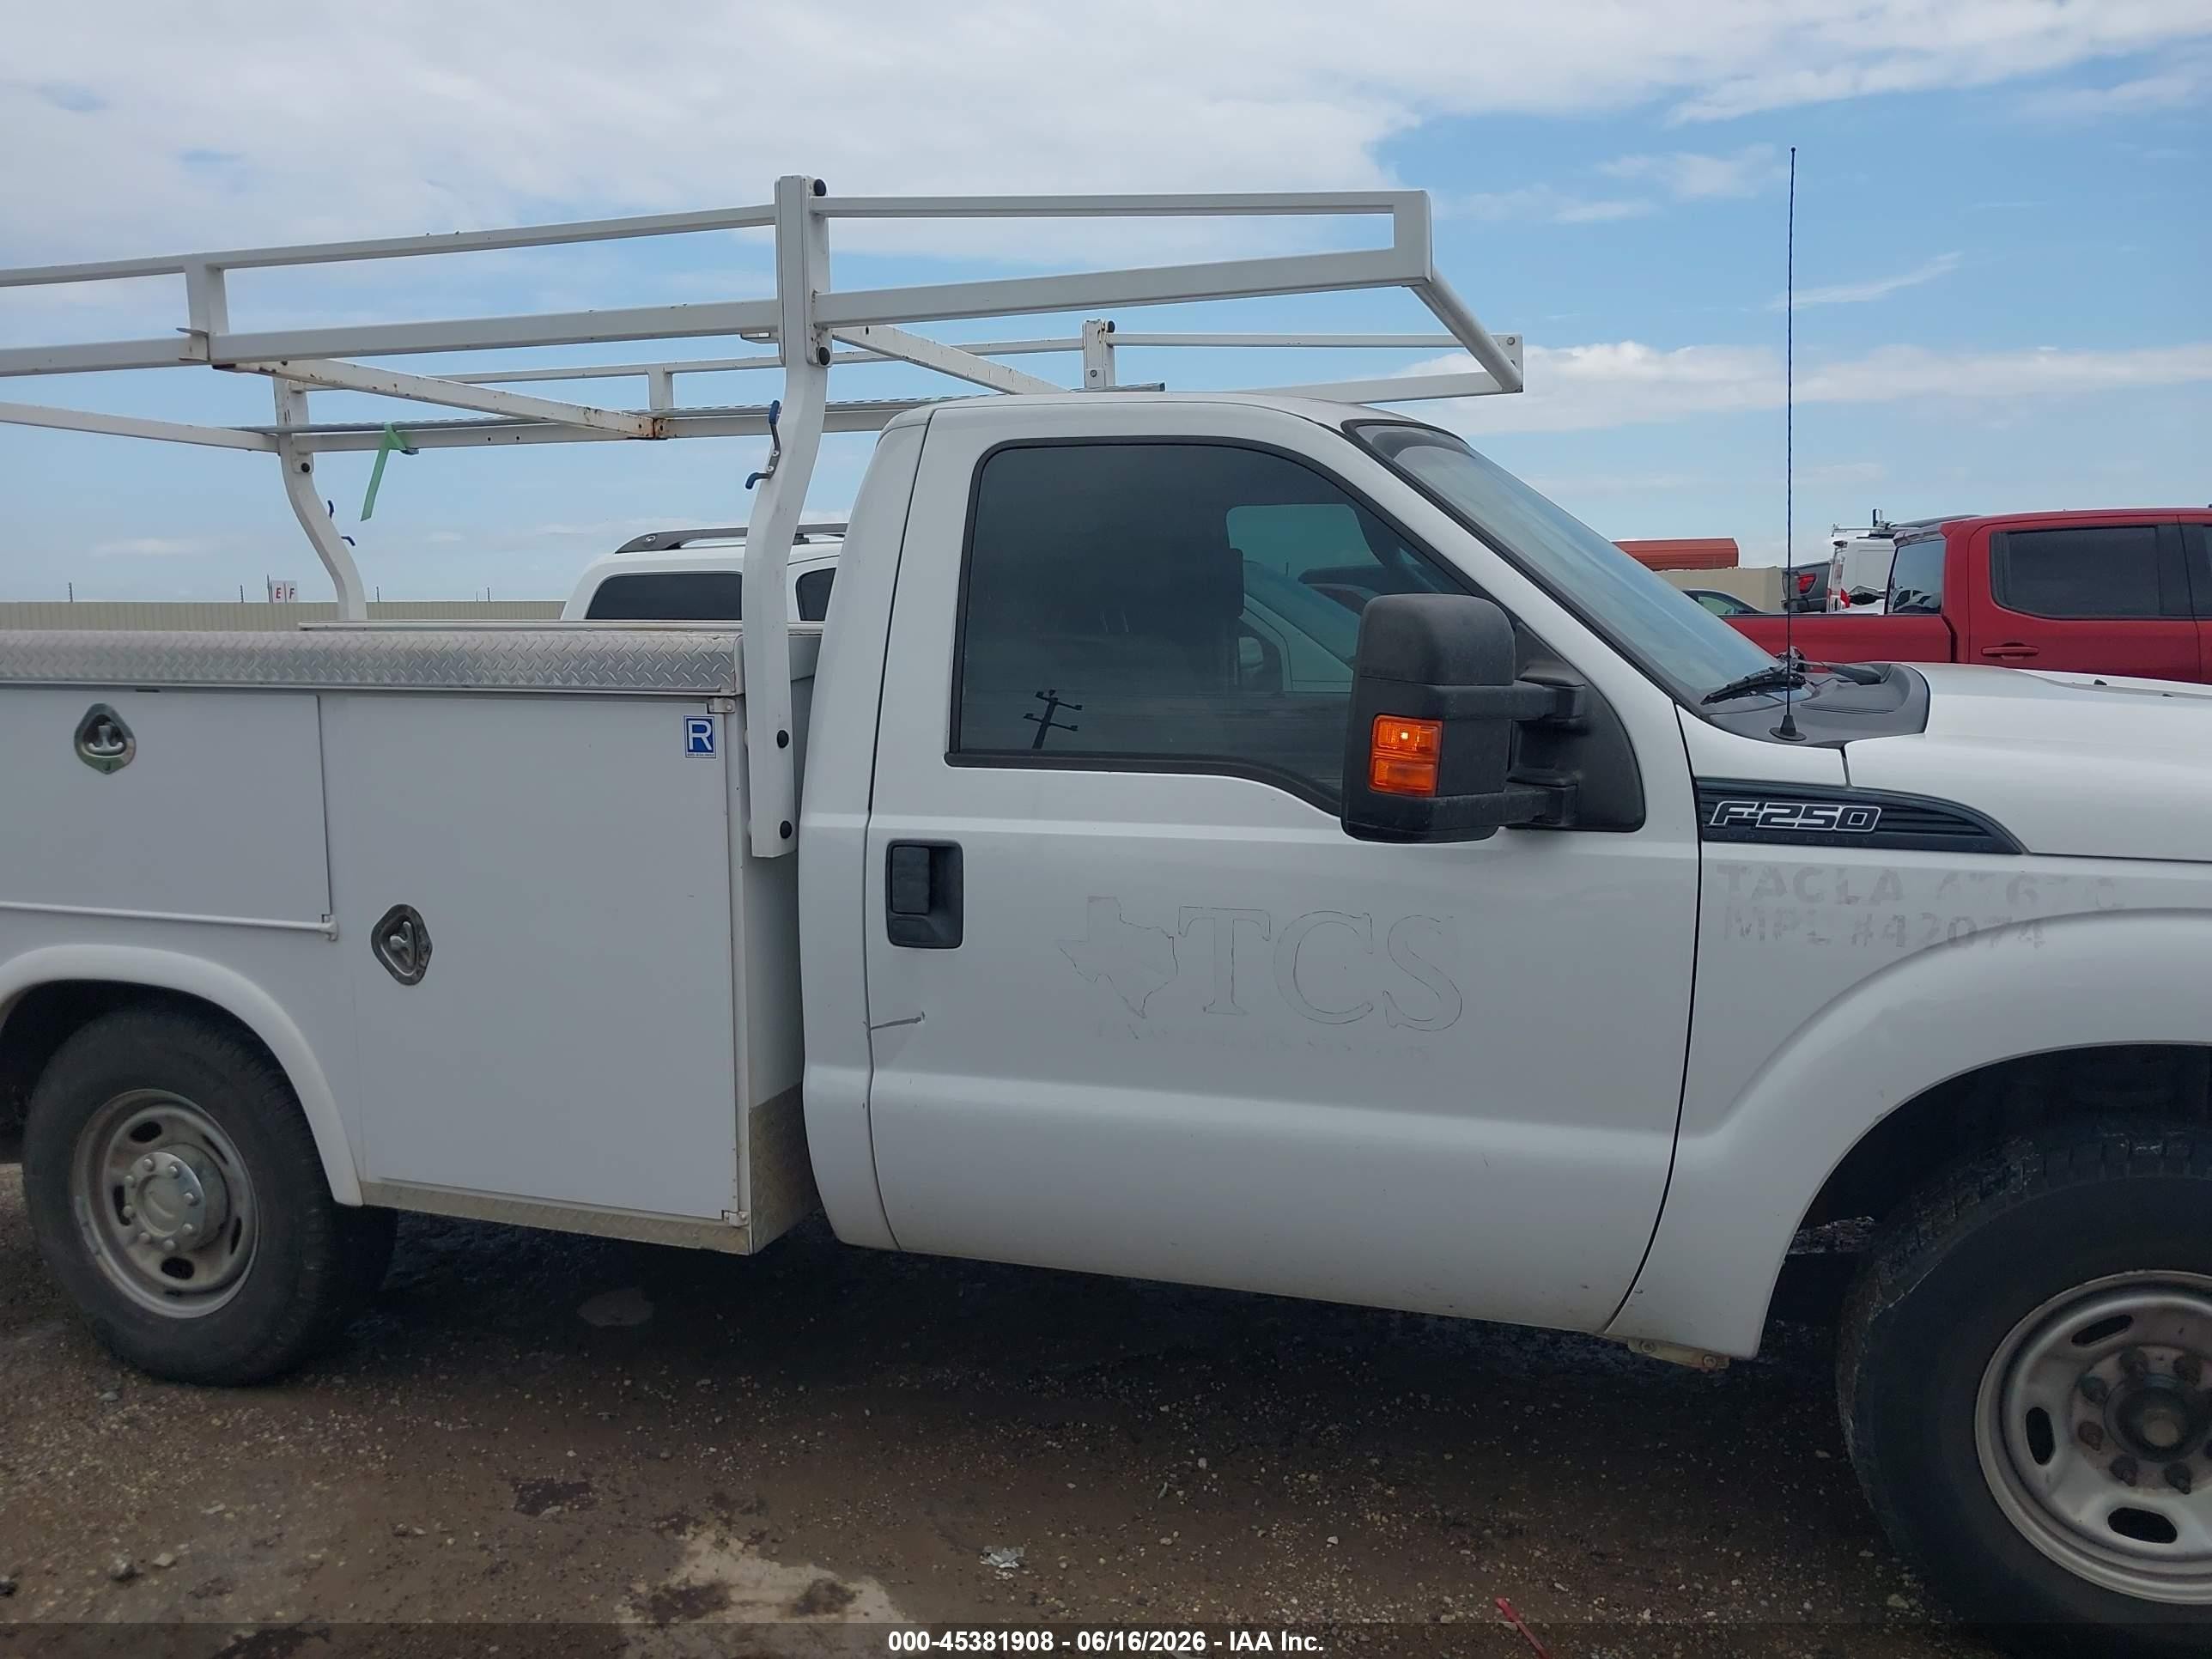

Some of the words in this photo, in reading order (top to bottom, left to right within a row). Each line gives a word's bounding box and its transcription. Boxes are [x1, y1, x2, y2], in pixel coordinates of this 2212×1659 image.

[688, 720, 713, 750] R
[1710, 799, 1882, 833] F-250
[1177, 905, 1463, 1032] TCS
